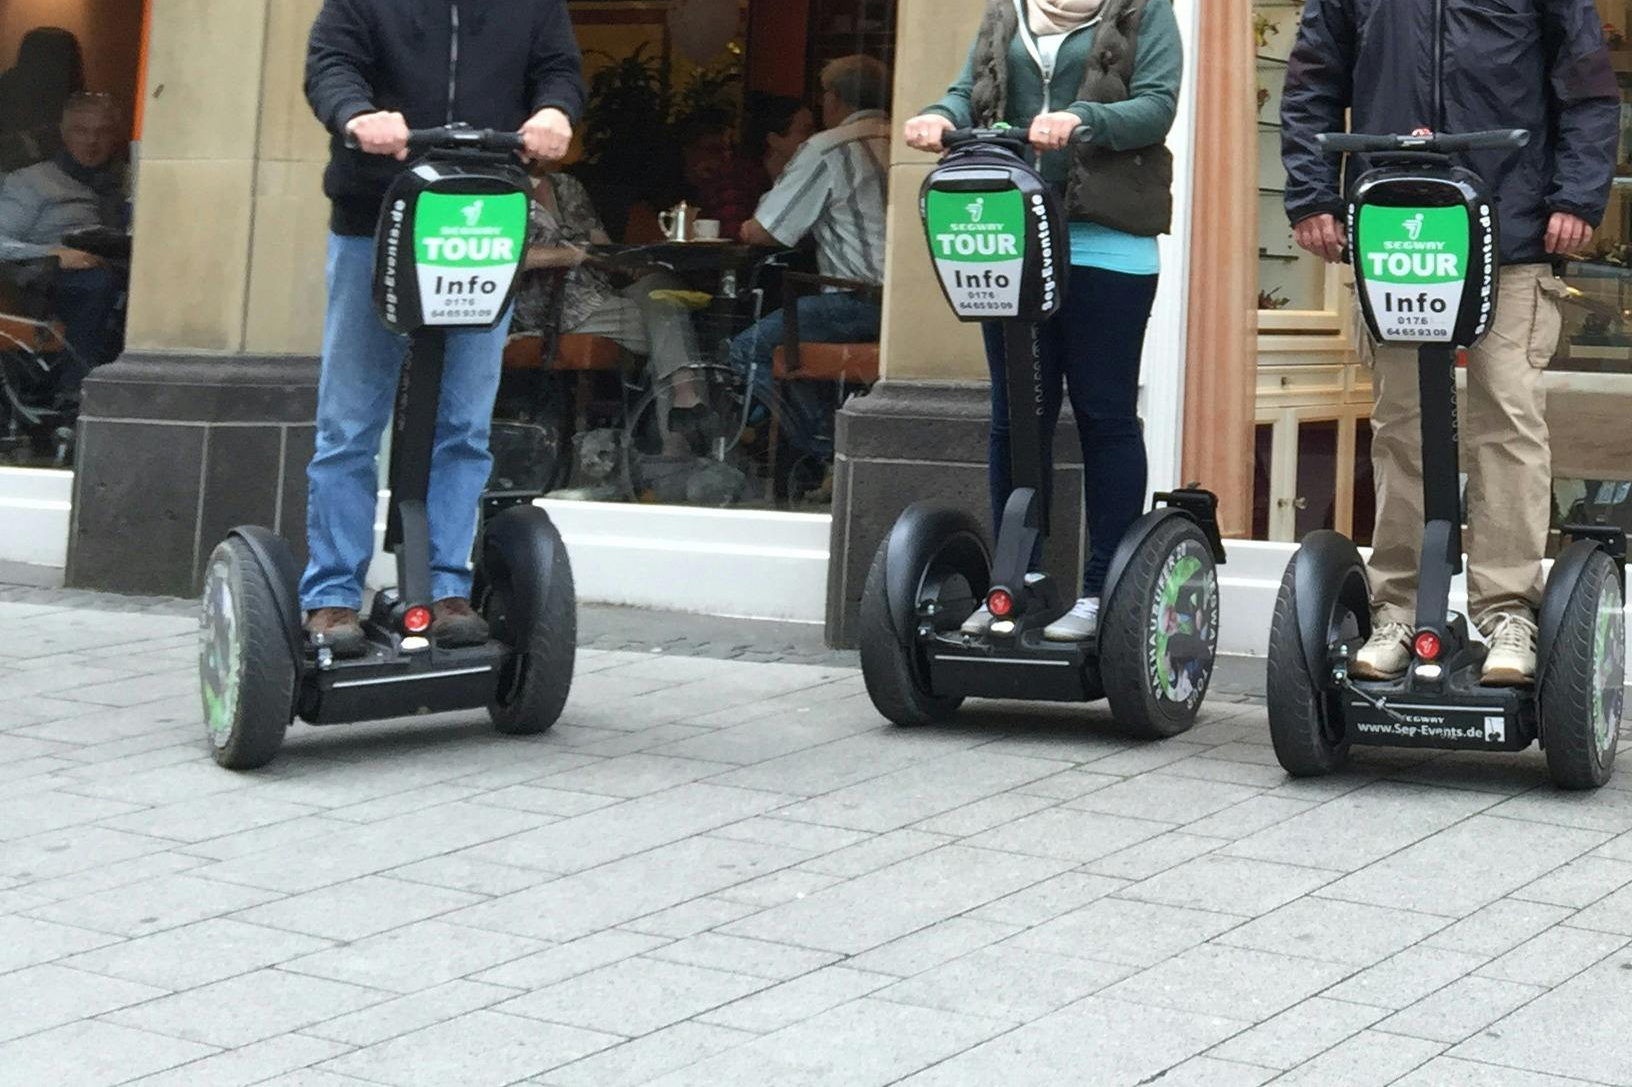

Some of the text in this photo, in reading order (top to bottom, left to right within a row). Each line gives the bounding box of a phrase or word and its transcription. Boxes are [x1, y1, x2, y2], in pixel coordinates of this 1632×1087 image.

[950, 223, 1005, 231] SEGWAY
[422, 237, 513, 260] TOUR
[936, 234, 1018, 255] TOUR
[1383, 241, 1446, 250] SEGWAY
[1367, 253, 1458, 277] TOUR
[434, 276, 496, 294] Info
[954, 270, 1009, 288] Info
[1385, 292, 1447, 313] Info
[1397, 317, 1428, 325] 0176
